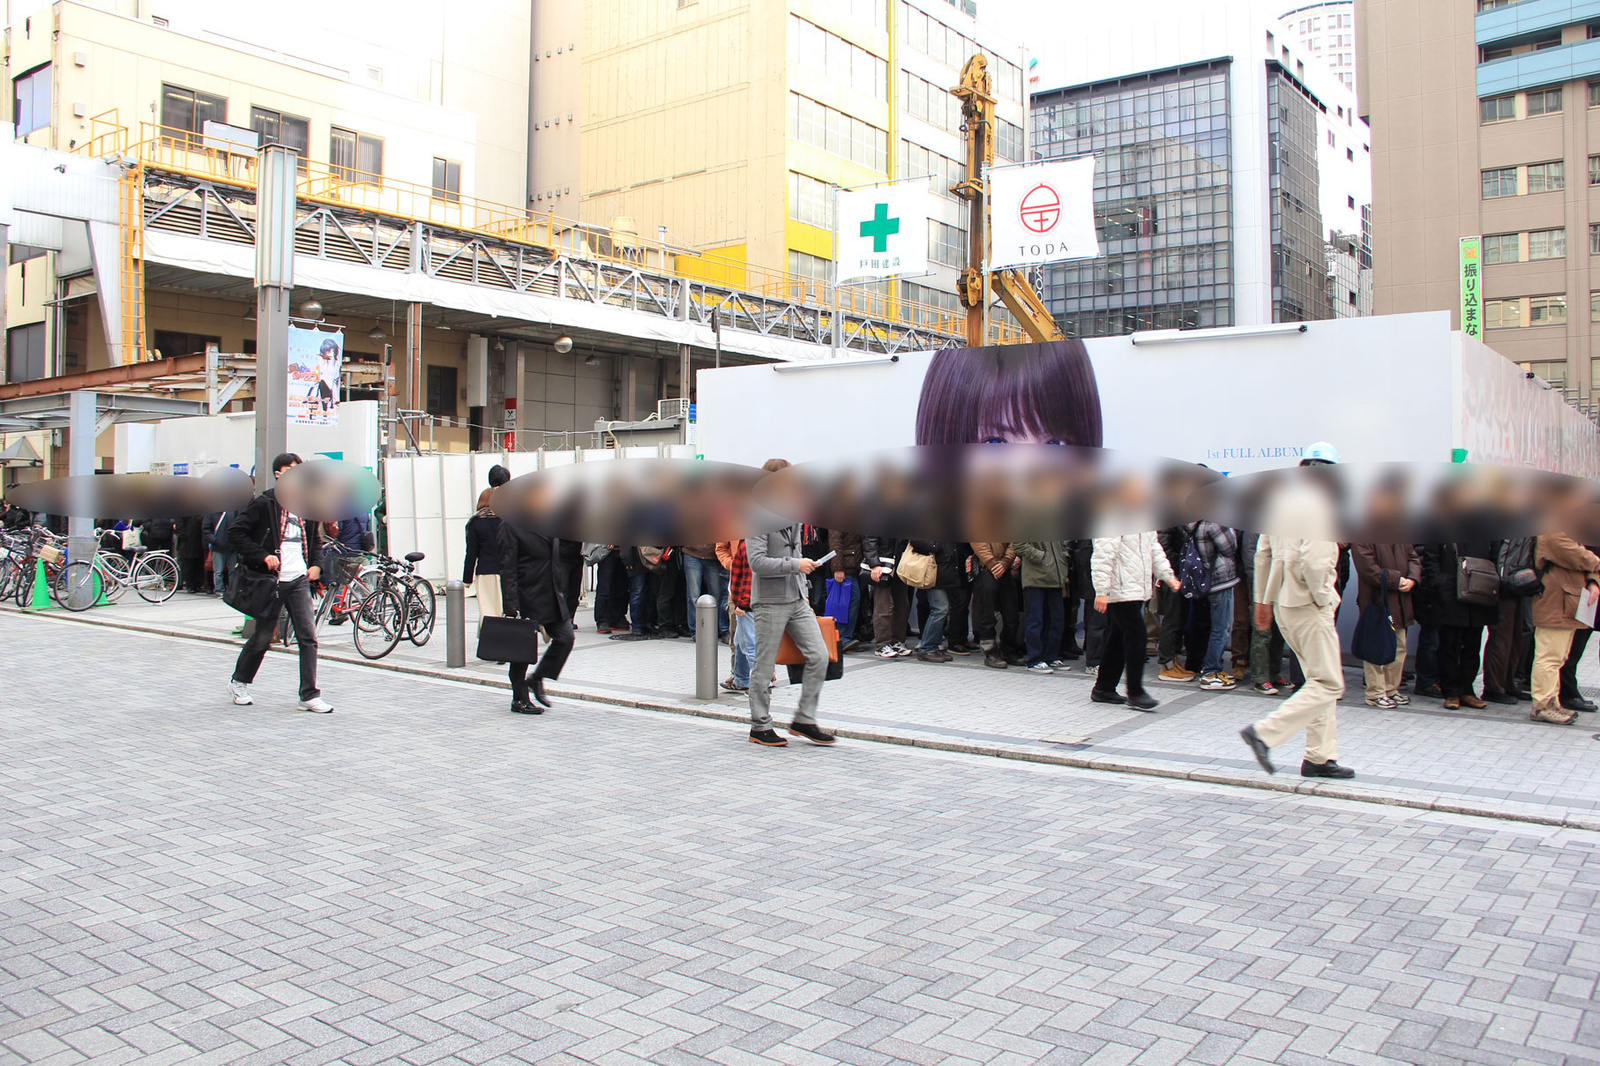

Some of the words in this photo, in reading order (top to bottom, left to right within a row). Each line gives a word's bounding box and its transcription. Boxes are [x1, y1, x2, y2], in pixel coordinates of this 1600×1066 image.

[1018, 241, 1069, 257] TODA
[860, 257, 901, 269] 戸田建設
[1463, 263, 1478, 337] 振り込まな
[1207, 449, 1220, 459] 1st
[1223, 447, 1255, 459] FULL
[1257, 446, 1304, 458] ALBUM
